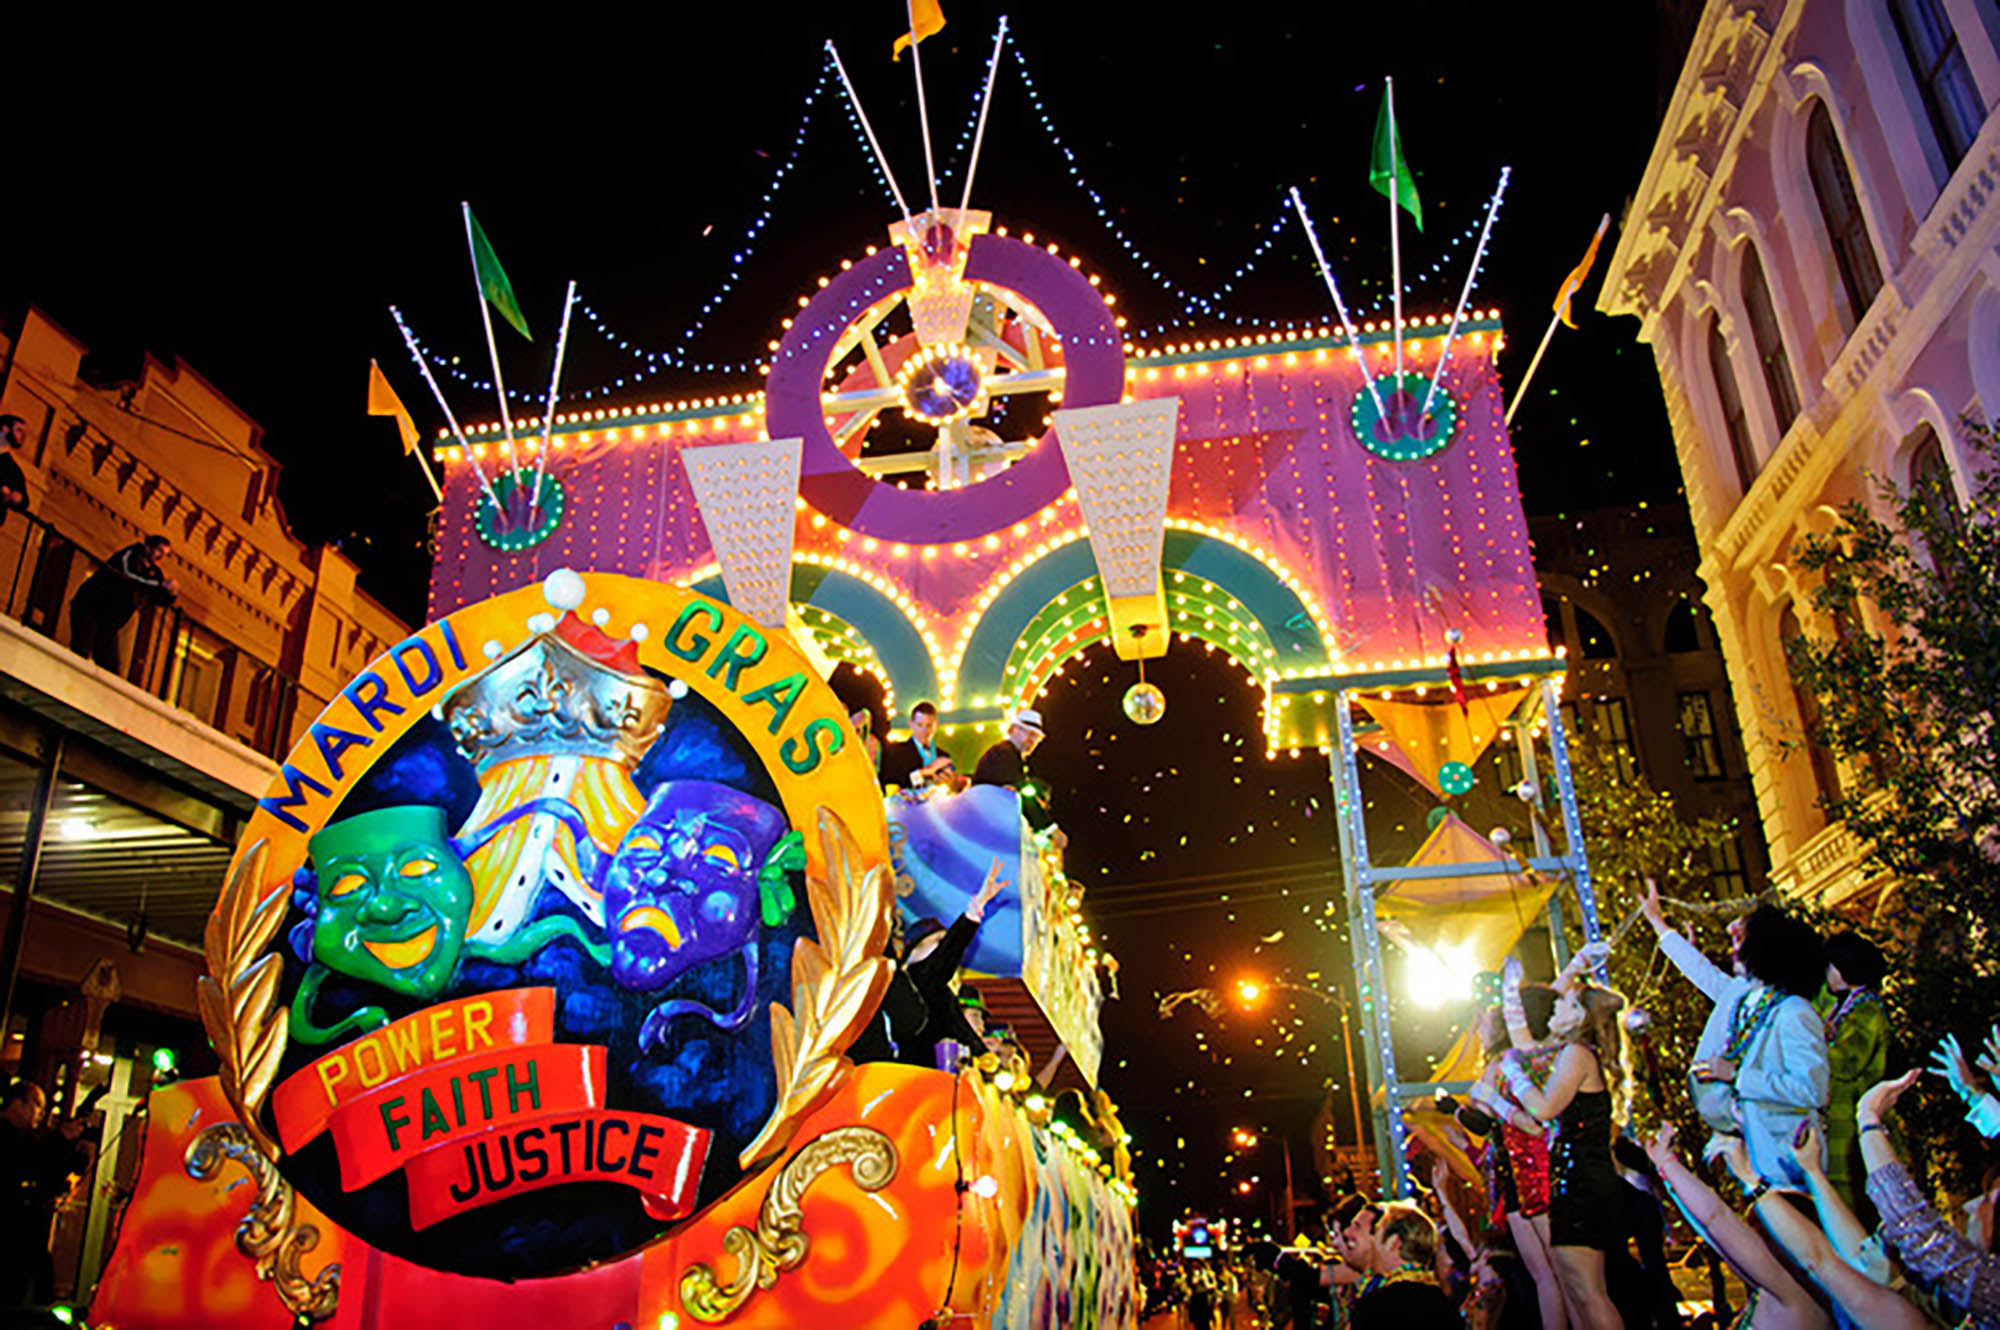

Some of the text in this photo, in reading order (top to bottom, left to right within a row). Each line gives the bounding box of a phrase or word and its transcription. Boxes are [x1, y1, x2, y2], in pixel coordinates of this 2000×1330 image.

[257, 599, 844, 834] MARDI GRAS
[316, 999, 495, 1107] POWER
[379, 1060, 541, 1151] FAITH
[449, 1119, 665, 1203] JUSTICE
